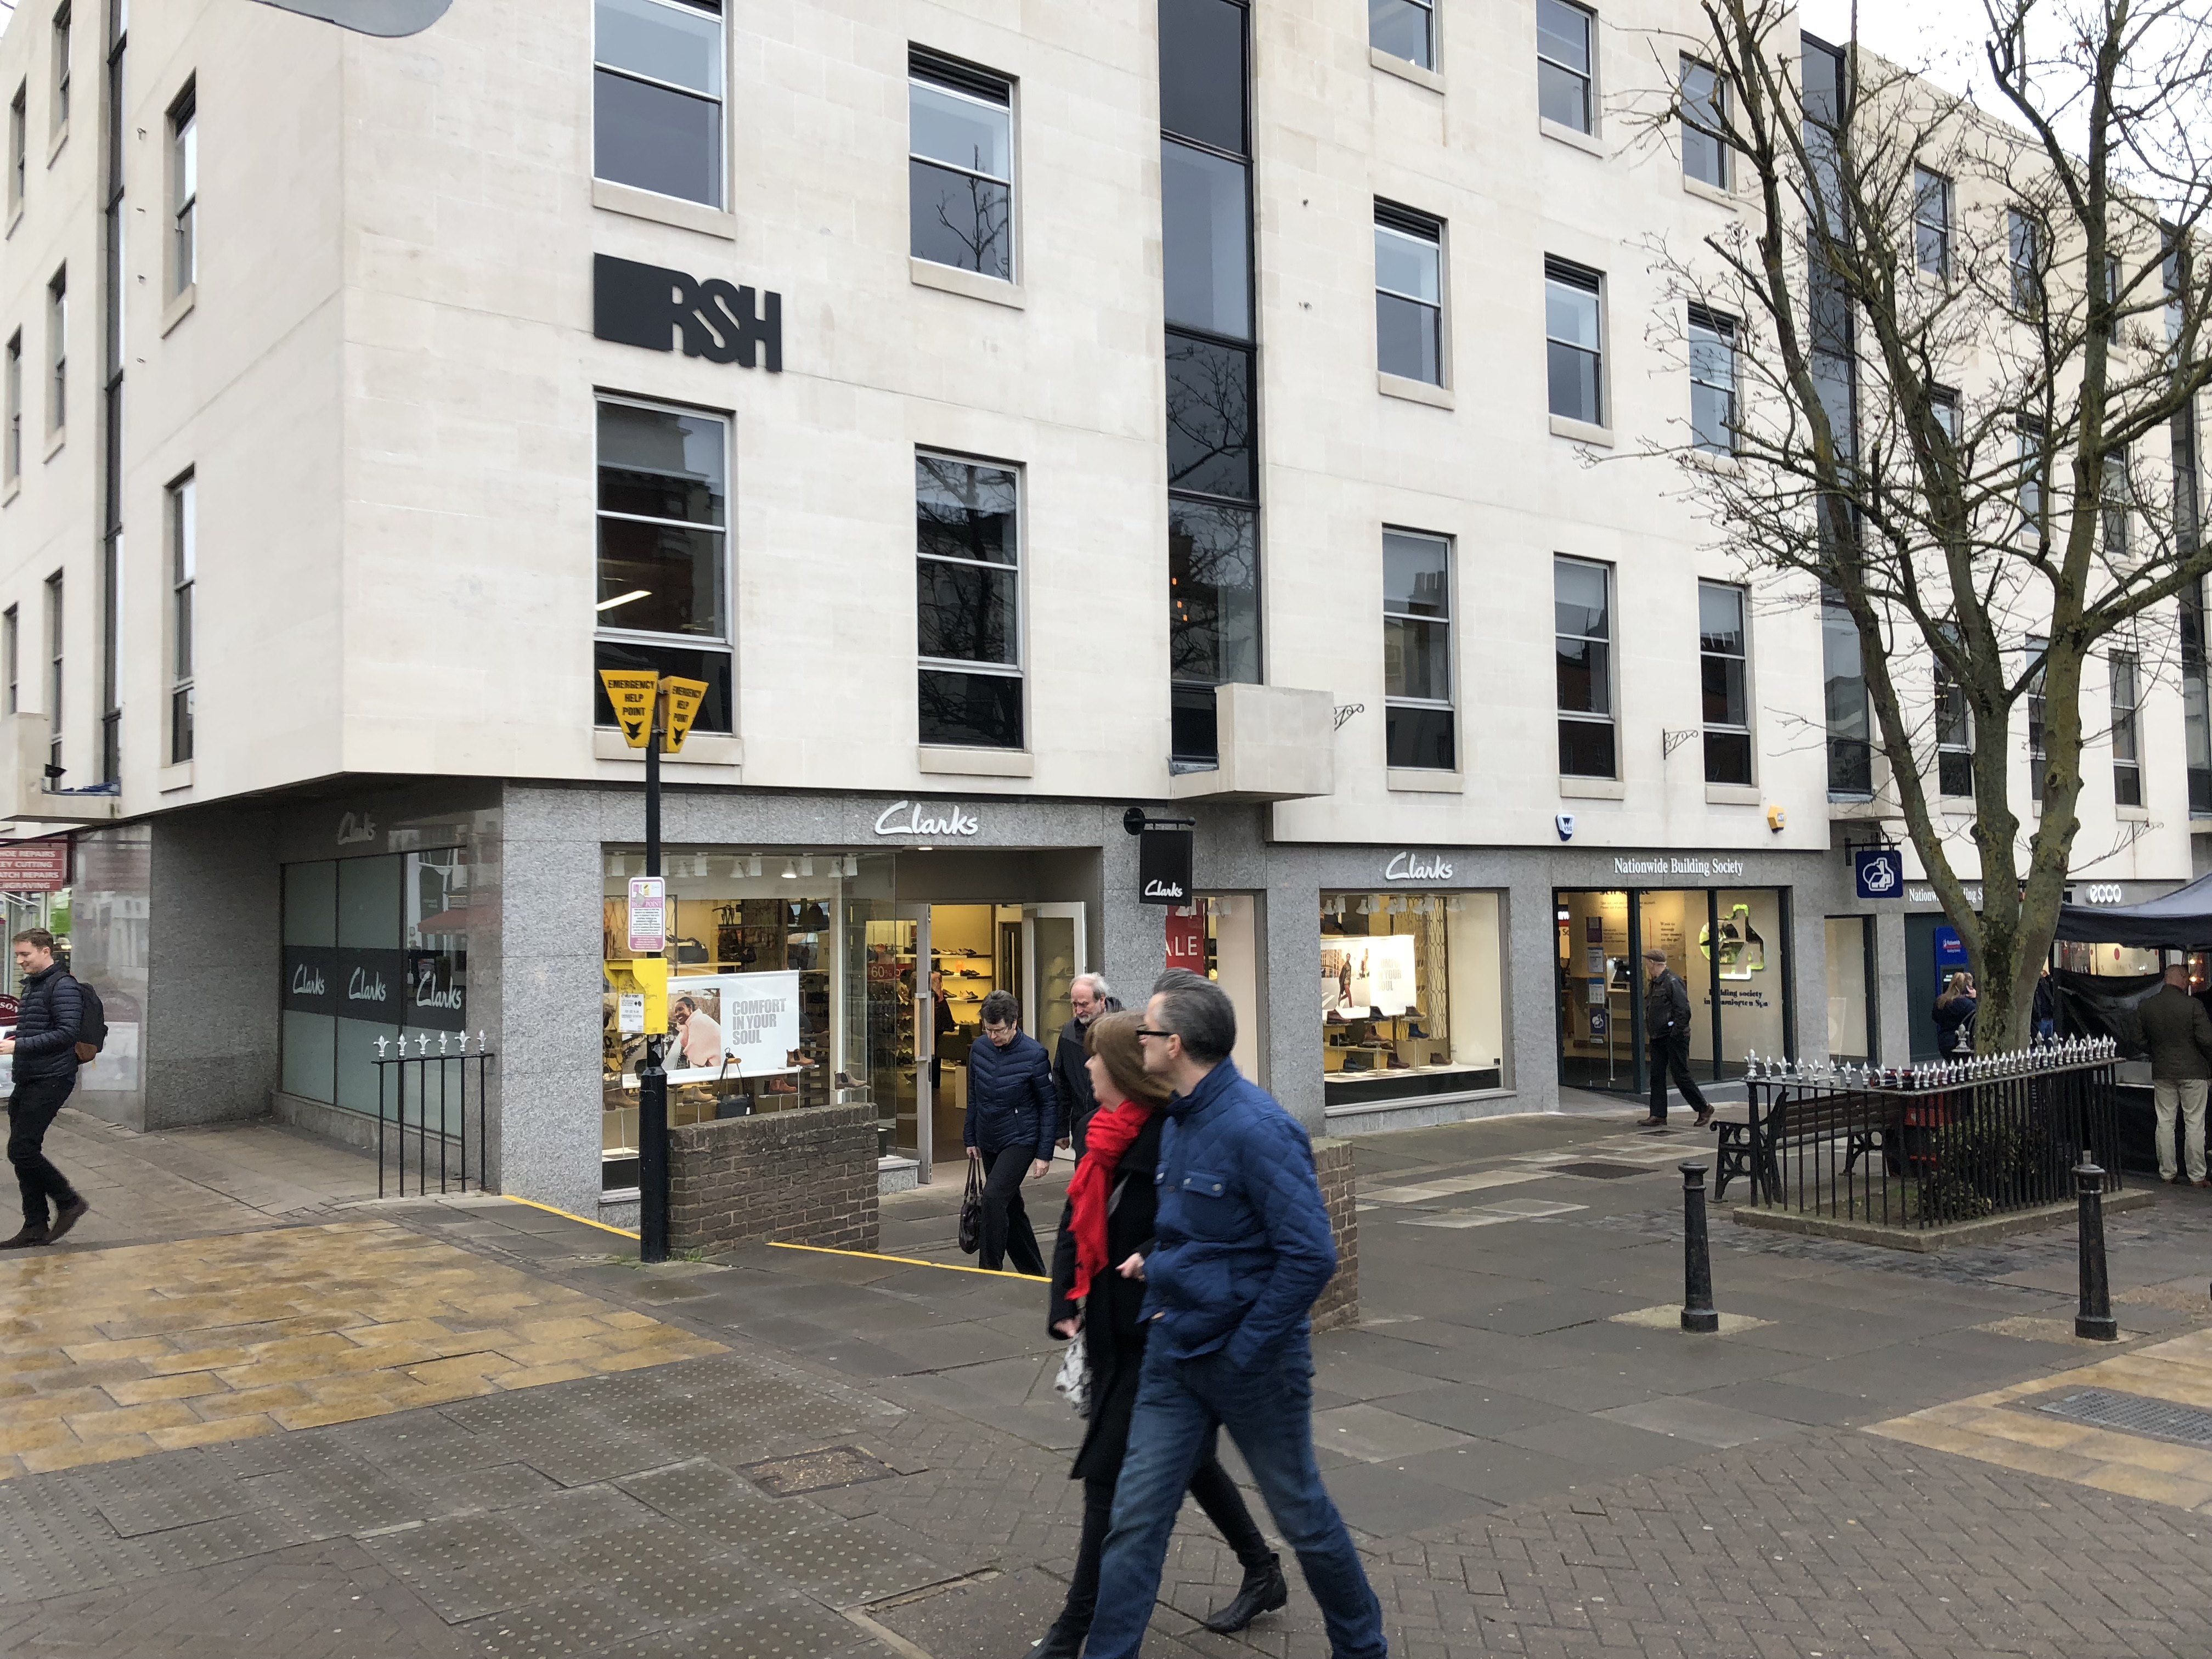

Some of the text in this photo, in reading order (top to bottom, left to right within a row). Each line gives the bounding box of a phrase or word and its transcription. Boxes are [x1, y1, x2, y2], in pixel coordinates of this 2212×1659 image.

[650, 266, 782, 366] RSH
[608, 680, 655, 690] EMERGENCY
[672, 686, 702, 699] EMERGENCY
[624, 693, 644, 702] HELP
[676, 700, 690, 709] HELP
[622, 707, 645, 716] POINT
[673, 713, 689, 723] POINT
[875, 800, 979, 835] Clarks
[1386, 851, 1453, 880] Clarks
[1614, 857, 1743, 877] Nationwide Building Society
[1144, 879, 1183, 898] Clarks
[292, 964, 325, 995] Clarks
[871, 966, 892, 978] 60%
[348, 967, 386, 1001] Clarks
[416, 970, 461, 1009] Clarks
[732, 998, 786, 1015] COMFORT
[733, 1013, 777, 1030] IN YOUR
[732, 1029, 762, 1045] SOUL
